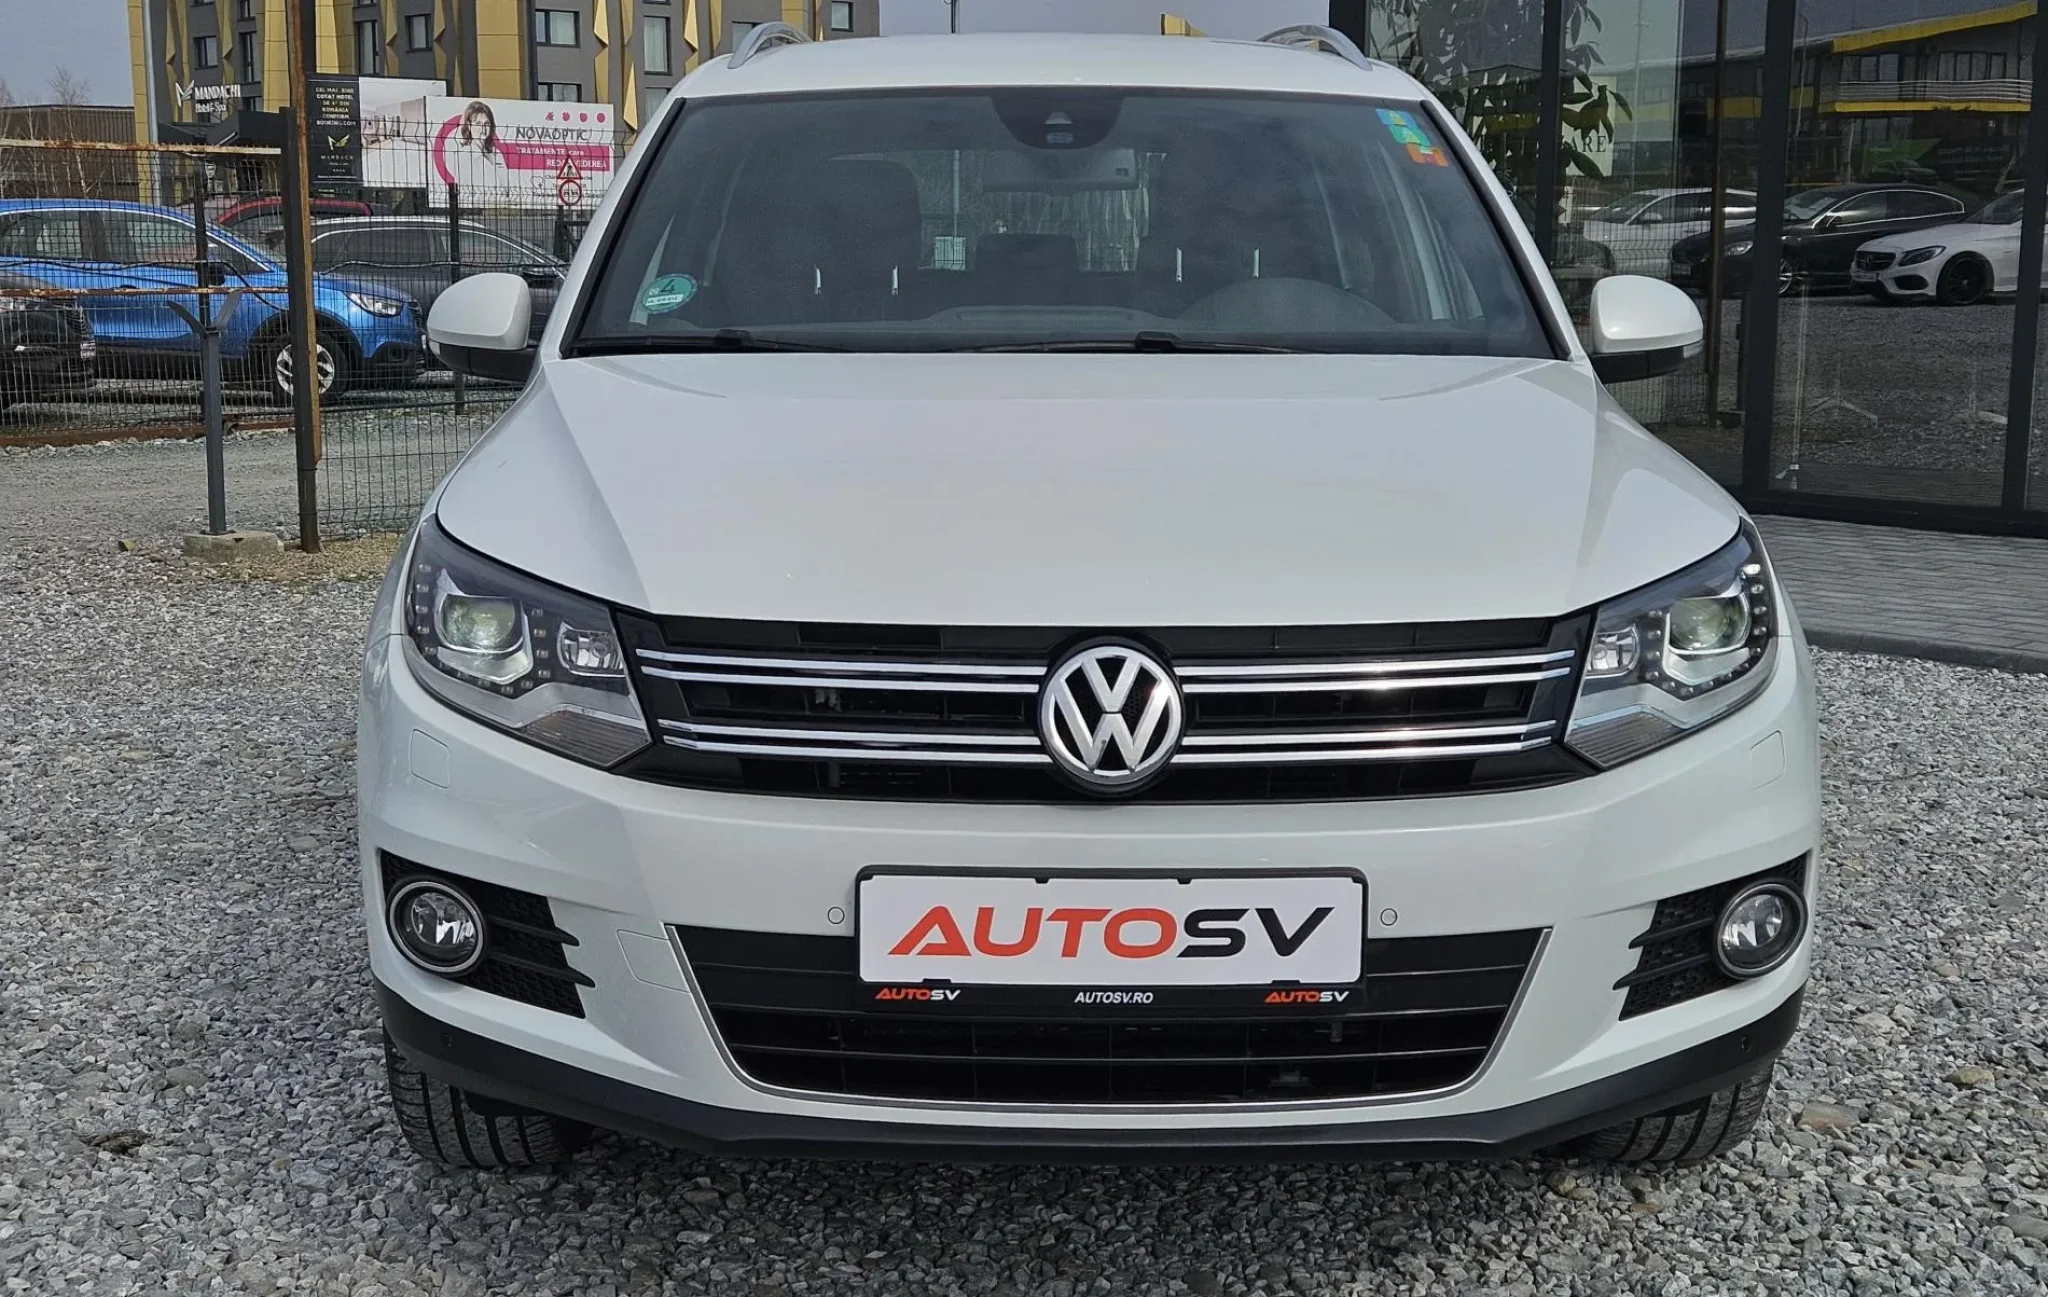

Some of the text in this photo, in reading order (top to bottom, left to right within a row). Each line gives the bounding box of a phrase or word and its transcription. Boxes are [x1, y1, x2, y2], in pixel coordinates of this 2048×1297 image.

[194, 84, 241, 100] MANDACHI
[515, 127, 588, 141] NOVAOPTIC
[887, 905, 1335, 959] AUTOSV
[875, 987, 961, 1001] AUTOSV
[1074, 991, 1154, 1004] AUTOSV.RO
[1264, 990, 1350, 1003] AUTOSV
